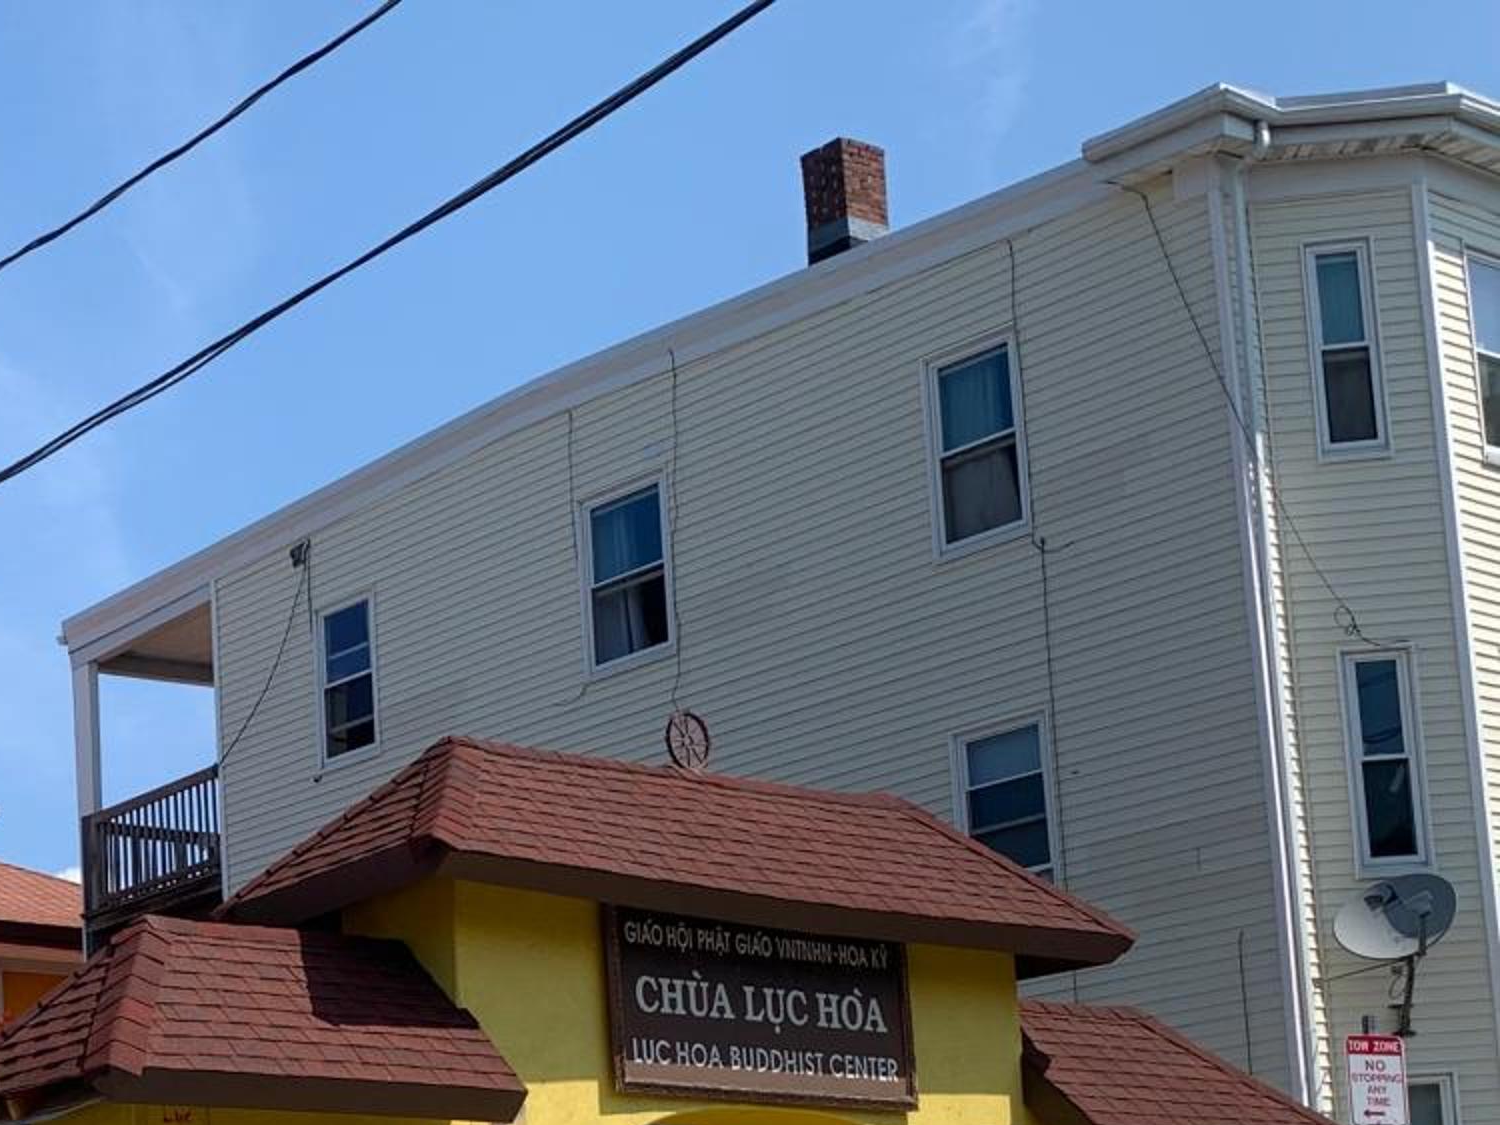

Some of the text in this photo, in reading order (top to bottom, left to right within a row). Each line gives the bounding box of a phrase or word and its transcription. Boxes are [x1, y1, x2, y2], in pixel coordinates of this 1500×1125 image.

[623, 918, 663, 947] GIÁO
[735, 931, 773, 957] GIÁO
[634, 969, 888, 1035] CHÙA LỤC HÒA
[1348, 1040, 1400, 1053] TOW ZONE
[632, 1037, 899, 1082] LUC HOA BUDDHIST CENTER
[1365, 1060, 1387, 1071] NO
[1352, 1073, 1402, 1083] STOPPING
[1367, 1086, 1387, 1094] ANY
